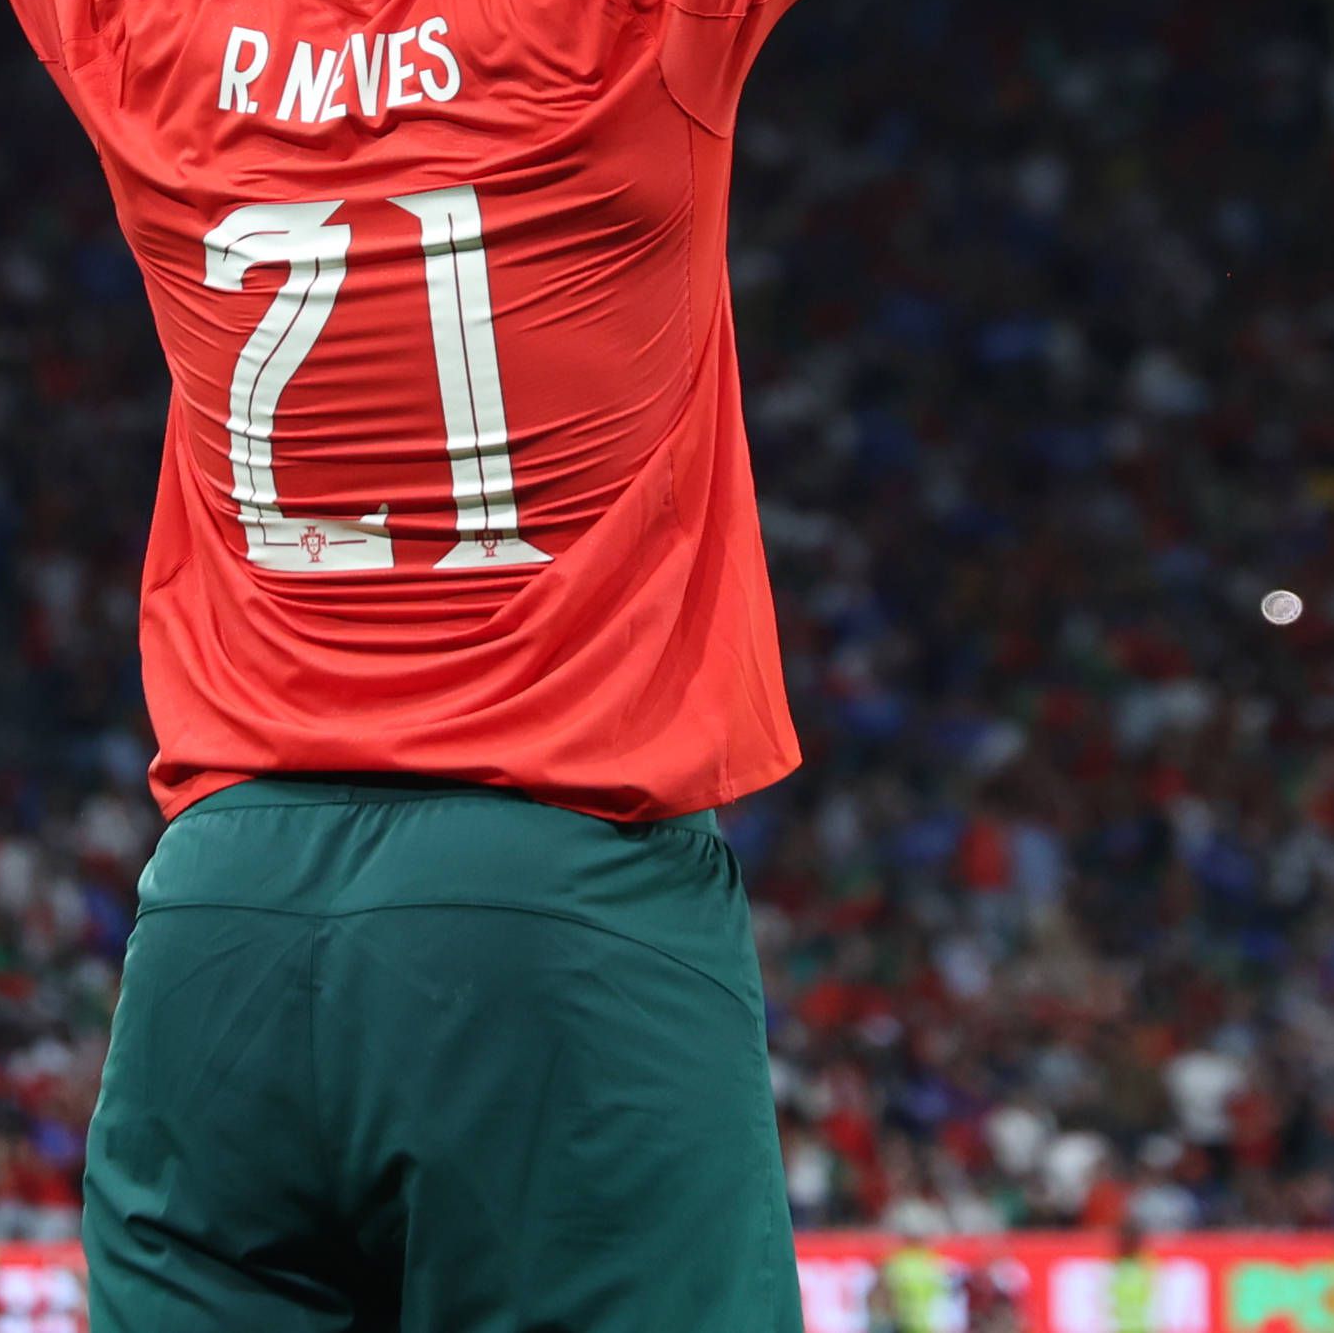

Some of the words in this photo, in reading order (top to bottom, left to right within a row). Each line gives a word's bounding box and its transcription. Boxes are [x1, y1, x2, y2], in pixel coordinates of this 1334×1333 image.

[218, 26, 269, 114] R.
[276, 17, 461, 123] NEVES
[204, 184, 554, 571] 21
